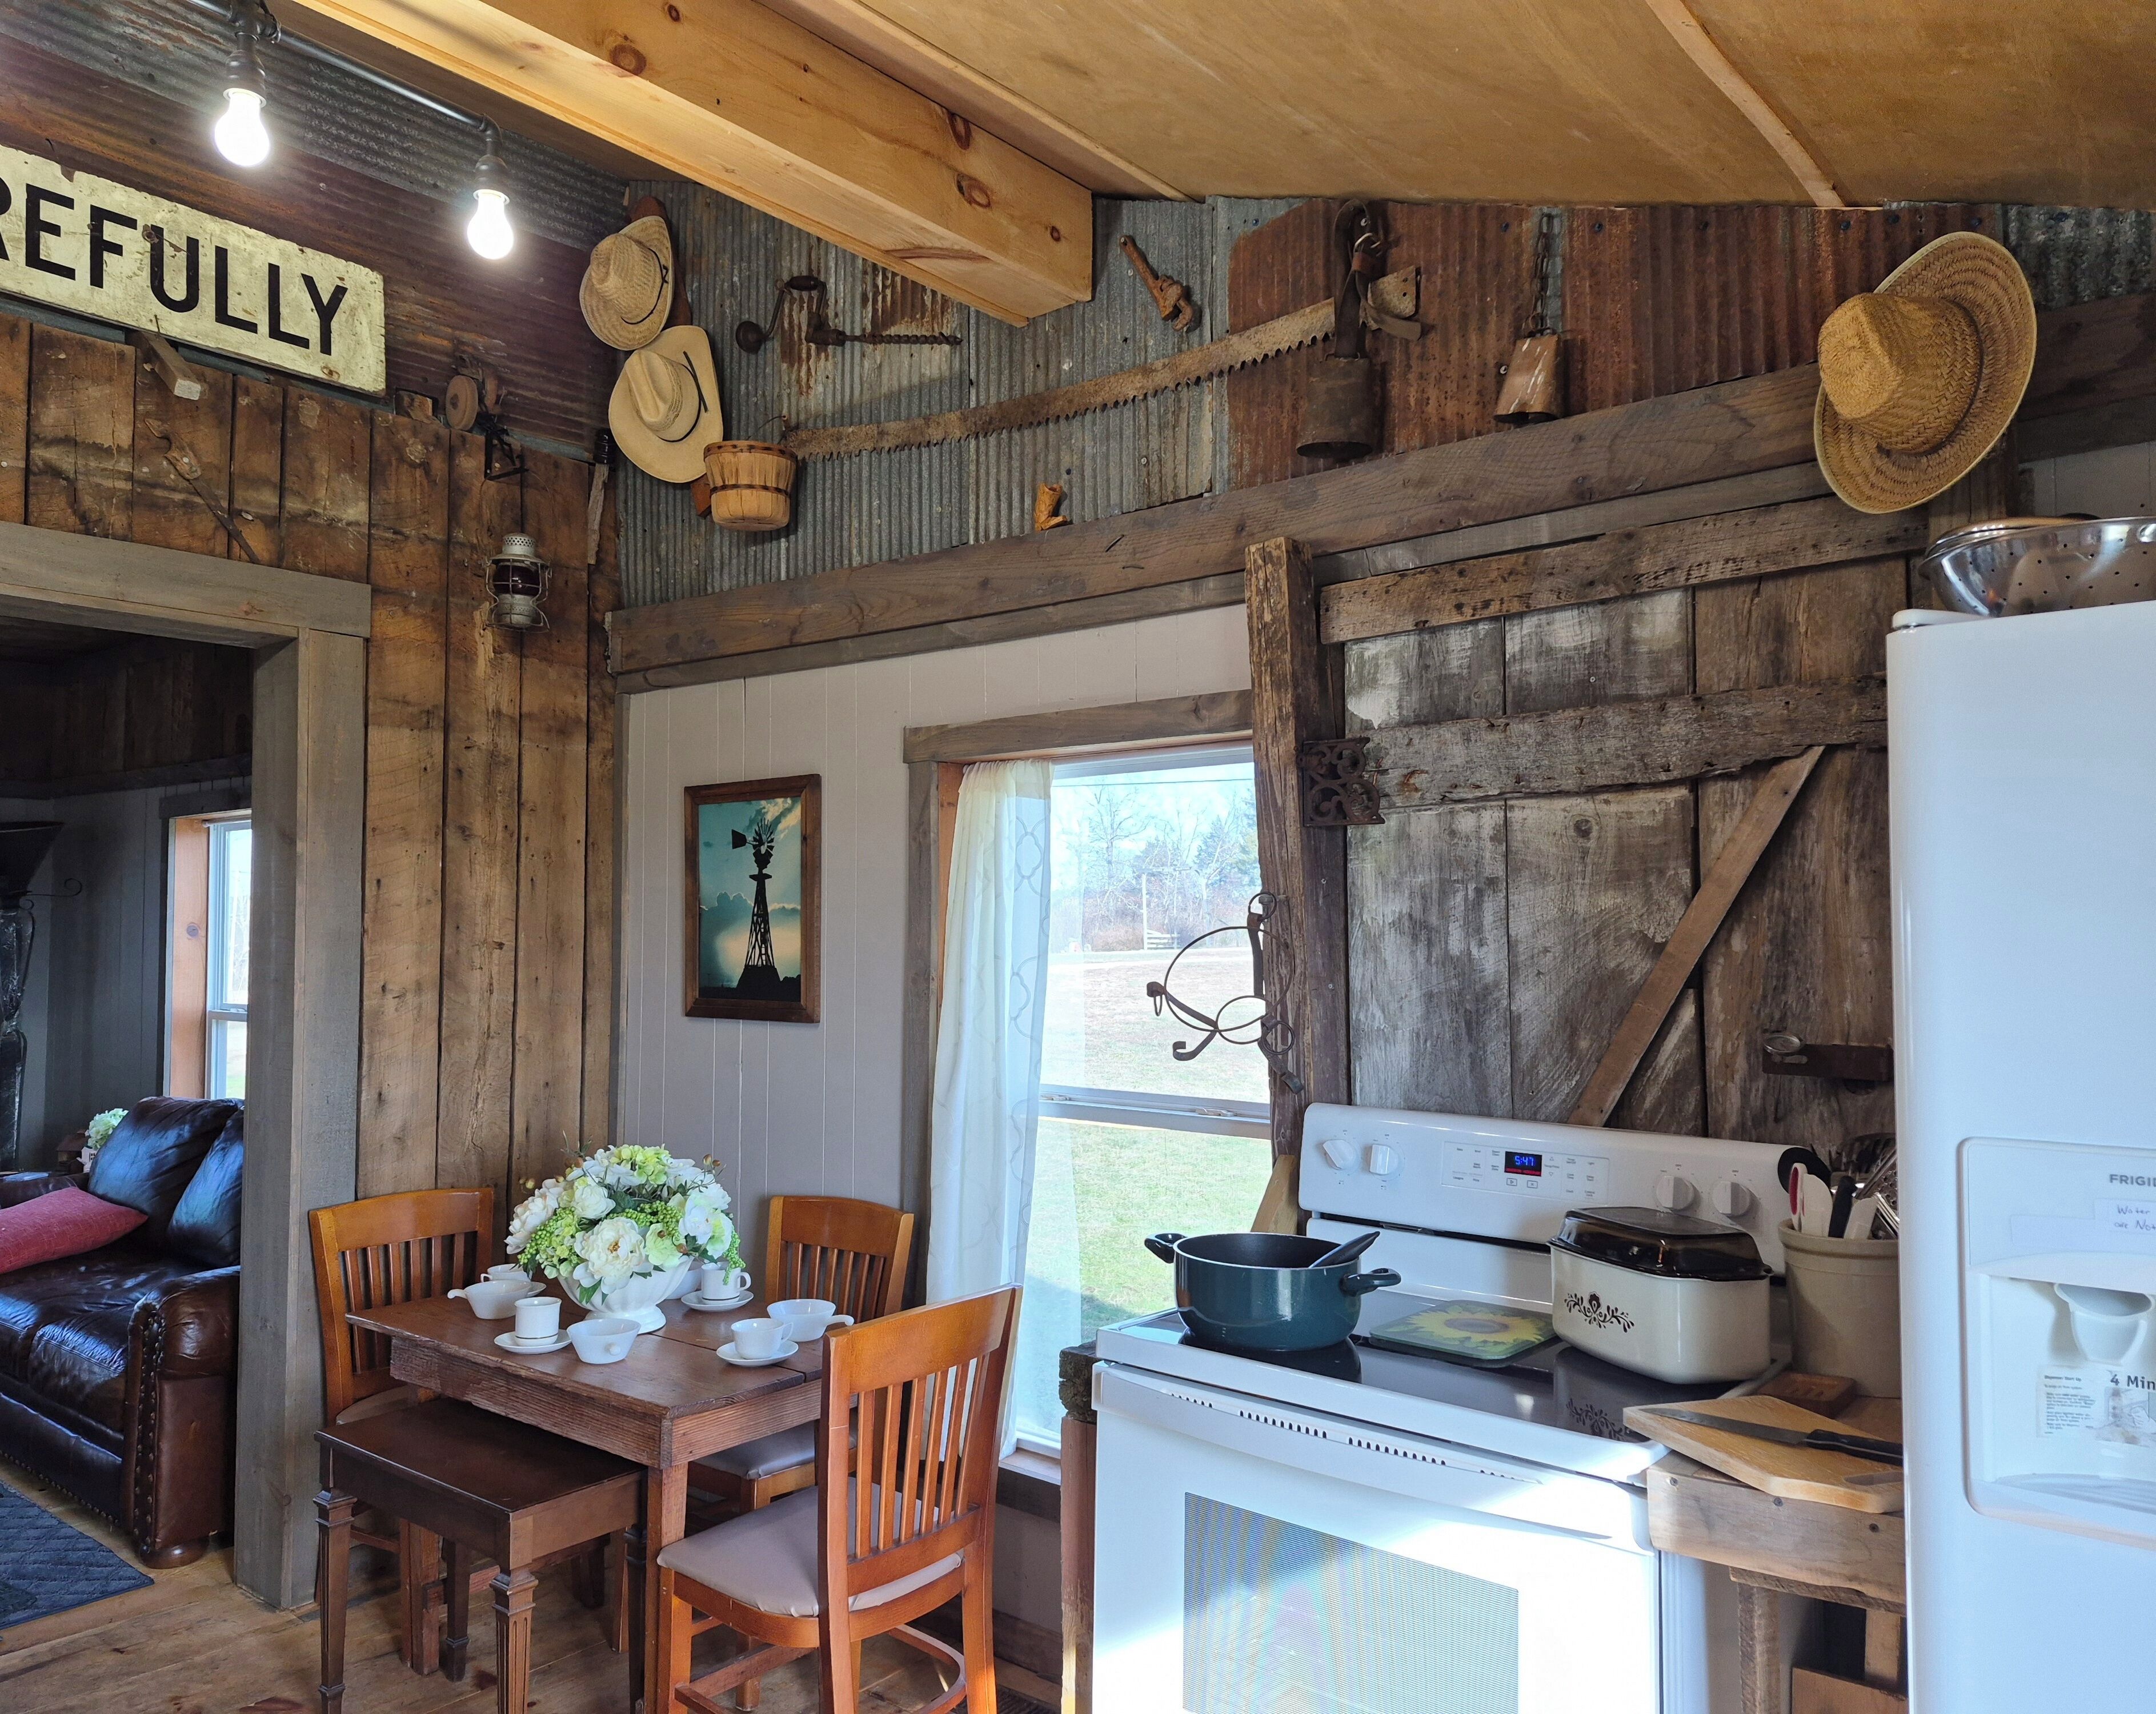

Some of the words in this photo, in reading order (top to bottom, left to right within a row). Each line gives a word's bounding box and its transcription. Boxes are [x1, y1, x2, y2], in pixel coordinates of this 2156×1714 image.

[0, 176, 348, 357] EFULLY
[1514, 1155, 1534, 1166] 5:47
[2117, 1204, 2150, 1215] Water
[2110, 1373, 2119, 1385] 4
